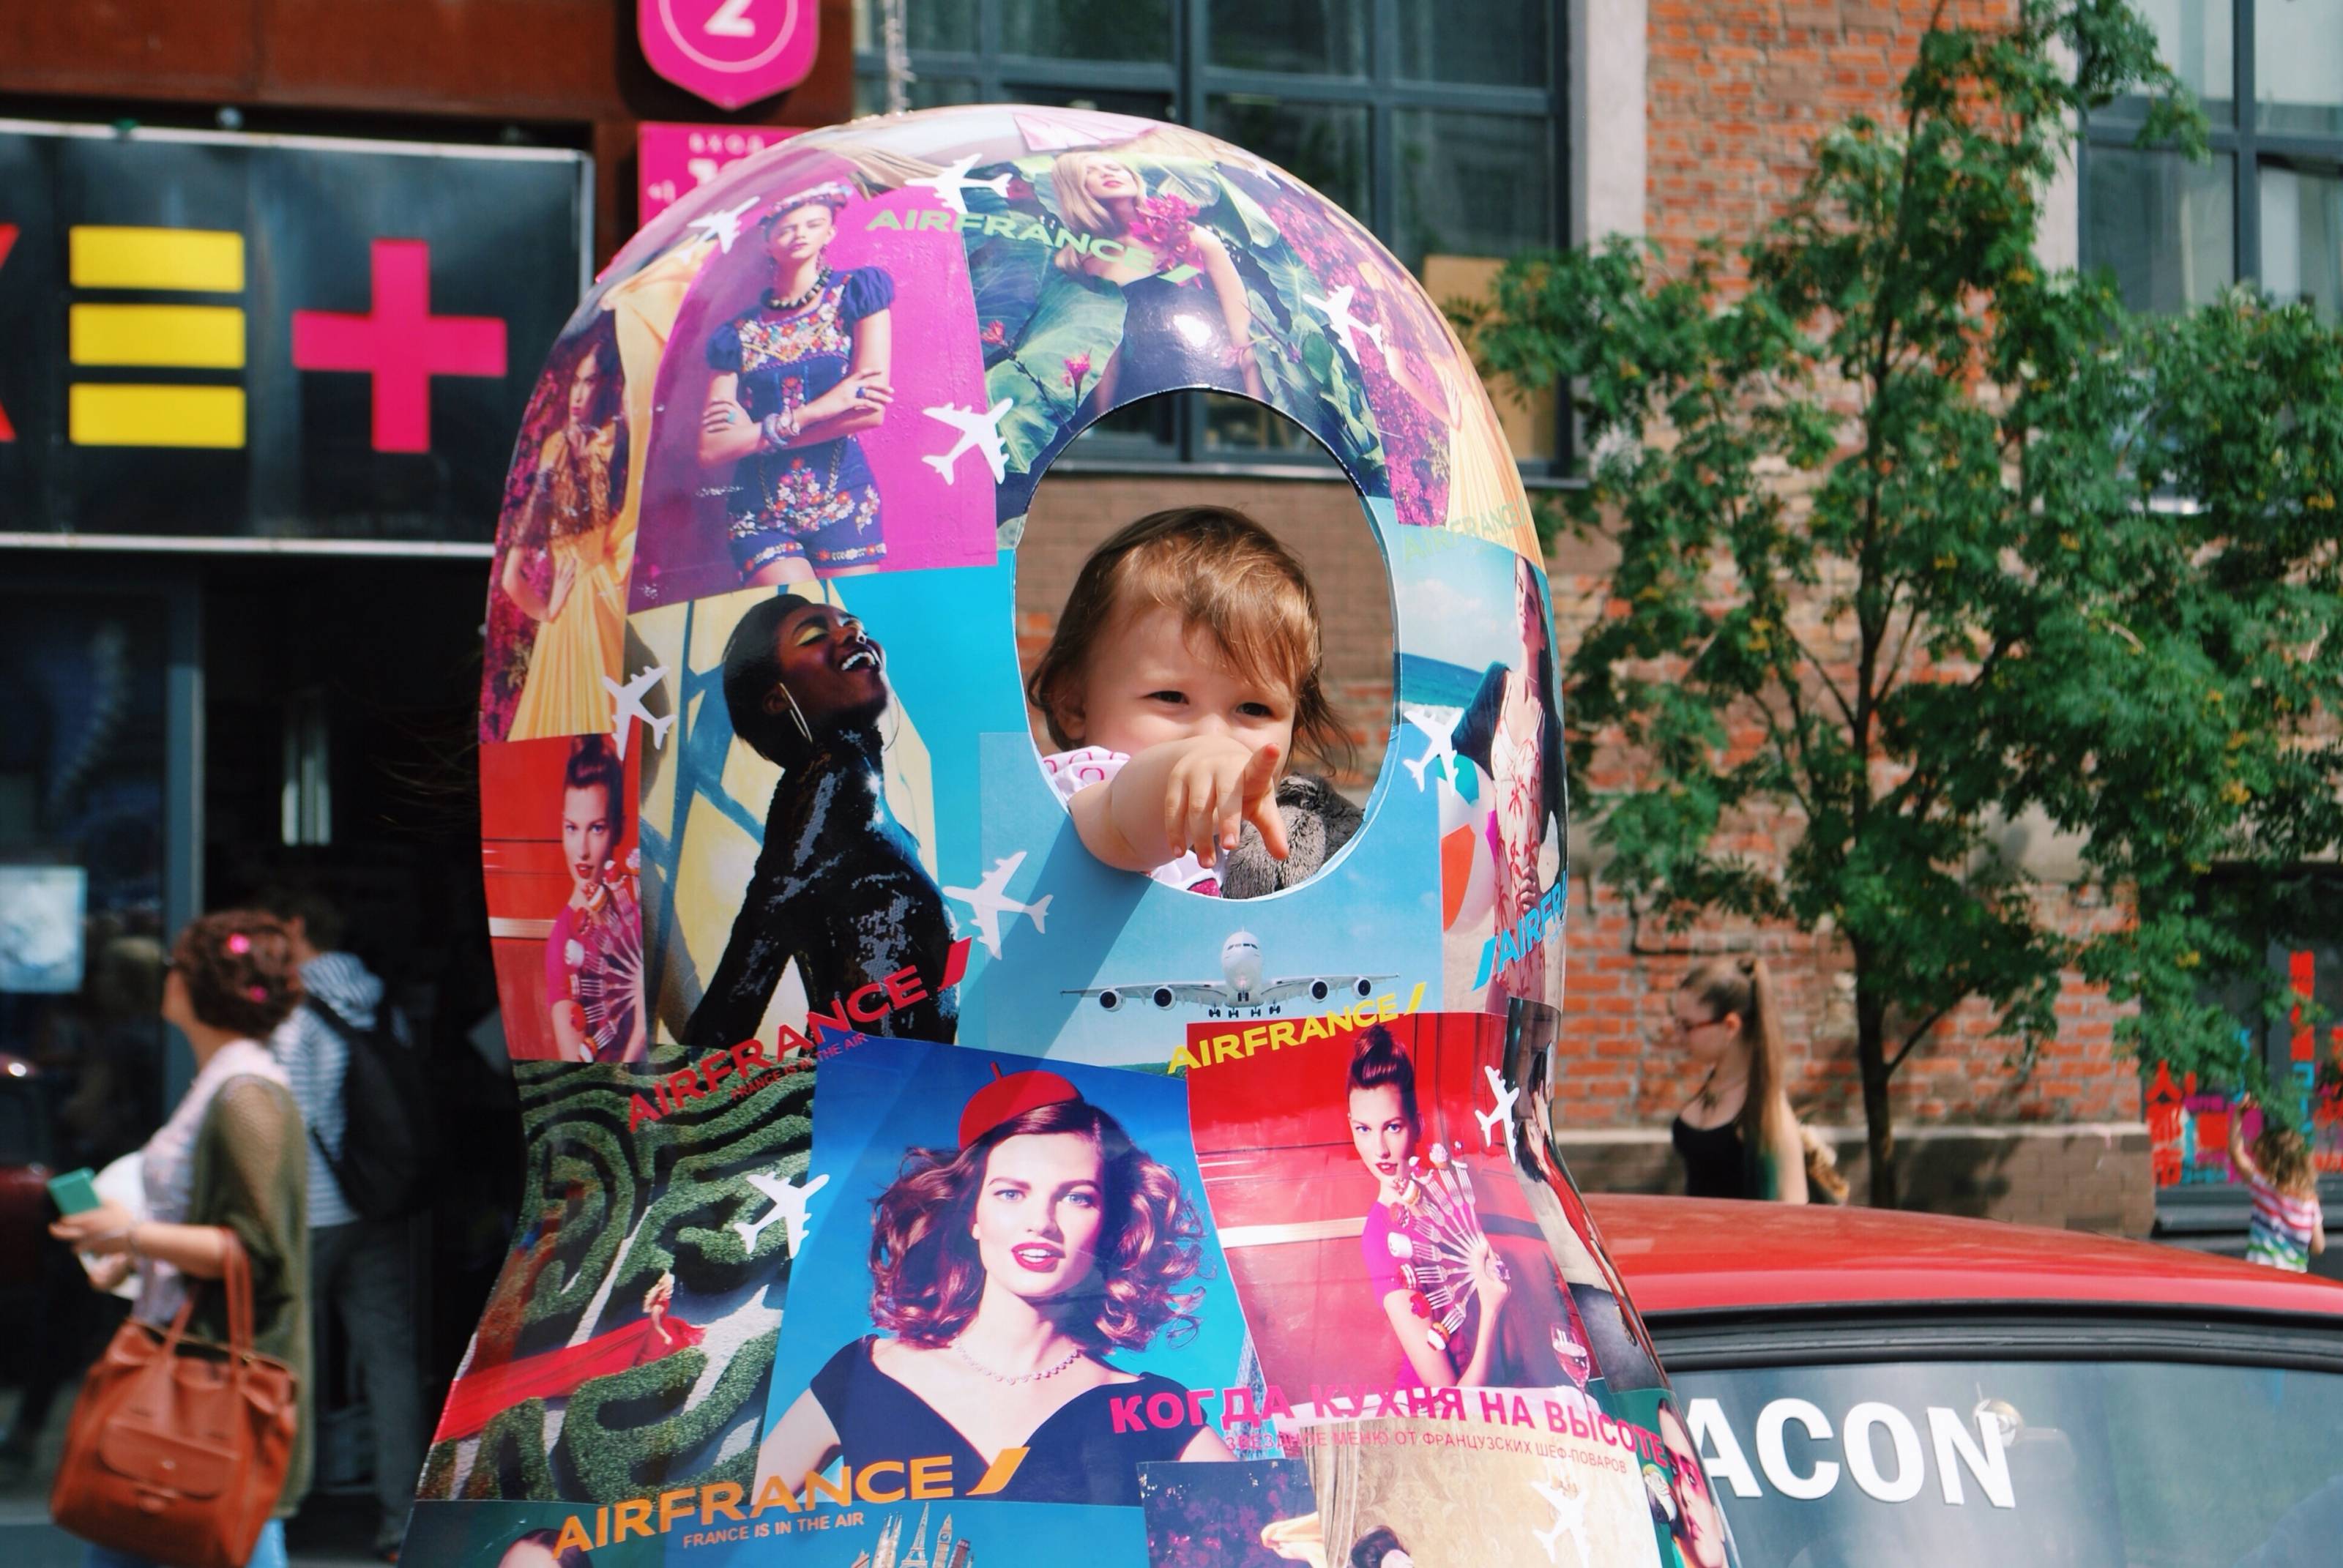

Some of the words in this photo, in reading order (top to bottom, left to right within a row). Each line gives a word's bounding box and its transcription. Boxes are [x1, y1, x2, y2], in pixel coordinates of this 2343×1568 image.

[865, 209, 1155, 272] AIRFRANCE
[627, 965, 928, 1134] AIRFRANCE
[731, 1069, 782, 1100] FRANCE
[783, 1064, 797, 1077] IS
[798, 1058, 813, 1071] IN
[815, 1043, 843, 1062] THE
[844, 1031, 869, 1050] AIR
[1168, 993, 1398, 1074] AIRFRANCE
[1110, 1385, 1296, 1434] КОГДА
[1309, 1384, 1467, 1421] КУХНЯ
[1479, 1391, 1536, 1430] НА
[1545, 1400, 1669, 1468] ВЫСОТЕ
[1226, 1431, 1328, 1451] ЗВЕЗДНОЕ
[1332, 1430, 1389, 1446] МЕНЮ
[1394, 1431, 1416, 1446] ОТ
[1423, 1432, 1532, 1455] ФРАНЦУЗСКИХ
[1536, 1443, 1628, 1474] ШЕФ-ПОВАРОВ
[552, 1455, 953, 1560] AIRFRANCE
[682, 1526, 749, 1549] FRANCE
[753, 1523, 770, 1538] IS
[774, 1520, 791, 1535] IN
[797, 1515, 830, 1532] THE
[835, 1512, 865, 1528] AIR
